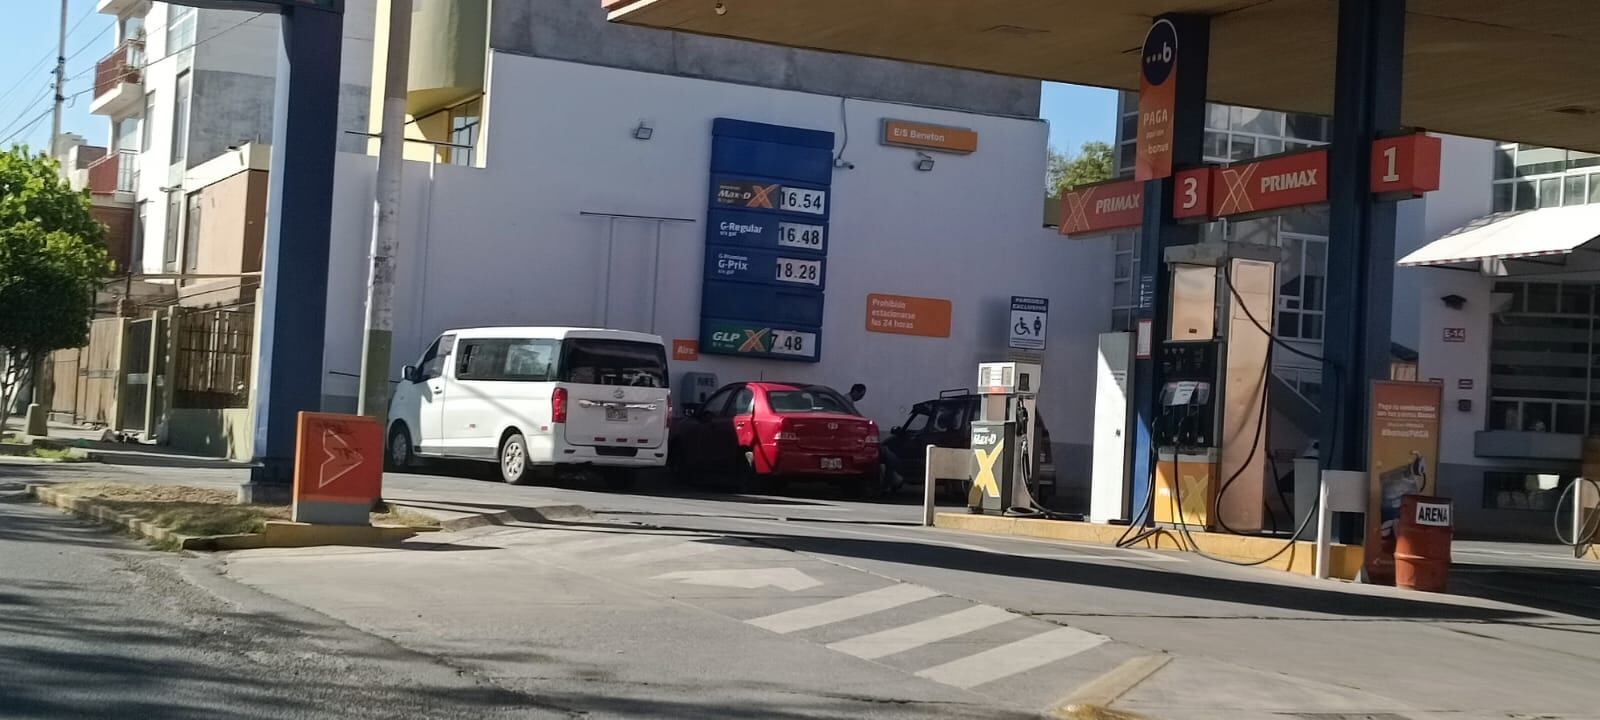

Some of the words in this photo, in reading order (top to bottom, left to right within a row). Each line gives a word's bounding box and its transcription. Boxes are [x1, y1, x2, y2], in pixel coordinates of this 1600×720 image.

[1143, 109, 1168, 126] PAGA
[1382, 146, 1400, 183] 1
[1261, 168, 1318, 194] PRIMAX
[780, 191, 822, 211] 16.54
[1095, 193, 1140, 214] PRIMAX
[1183, 177, 1198, 209] 3
[720, 221, 763, 234] G-Regular
[778, 226, 820, 246] 16.48
[718, 259, 749, 271] G-Prix
[776, 262, 817, 281] 18.28
[712, 331, 741, 342] GLP
[770, 333, 803, 352] 7.48
[1417, 505, 1449, 522] ARENA
